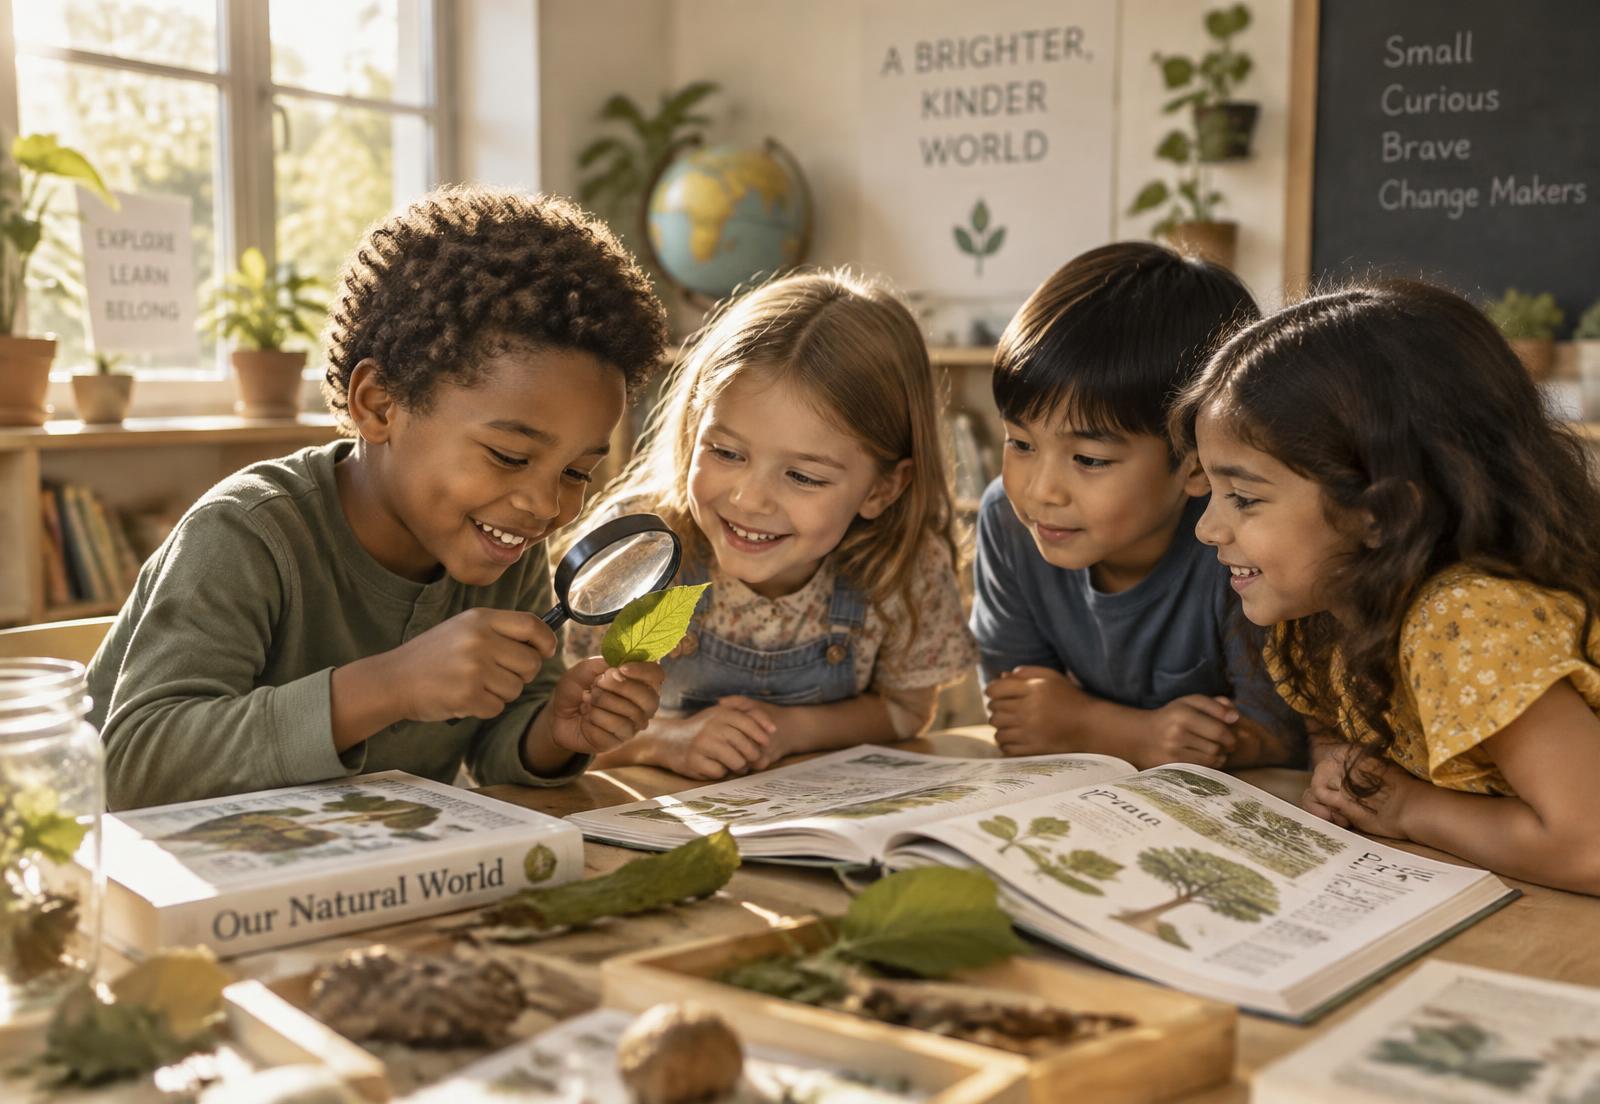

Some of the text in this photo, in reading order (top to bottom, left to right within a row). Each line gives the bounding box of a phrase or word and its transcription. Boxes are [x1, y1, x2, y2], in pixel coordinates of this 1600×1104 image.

[881, 26, 1094, 77] A BRIGHTER,
[1383, 31, 1473, 68] Small
[921, 80, 1048, 119] KINDER
[1380, 83, 1500, 116] Curious
[920, 130, 1049, 167] WORLD
[1381, 131, 1472, 162] Brave
[1378, 175, 1588, 220] Change Makers
[96, 228, 176, 253] EXPLORE
[109, 264, 169, 286] LEARN
[105, 300, 181, 321] BELONG
[211, 857, 505, 941] Our Natural World
